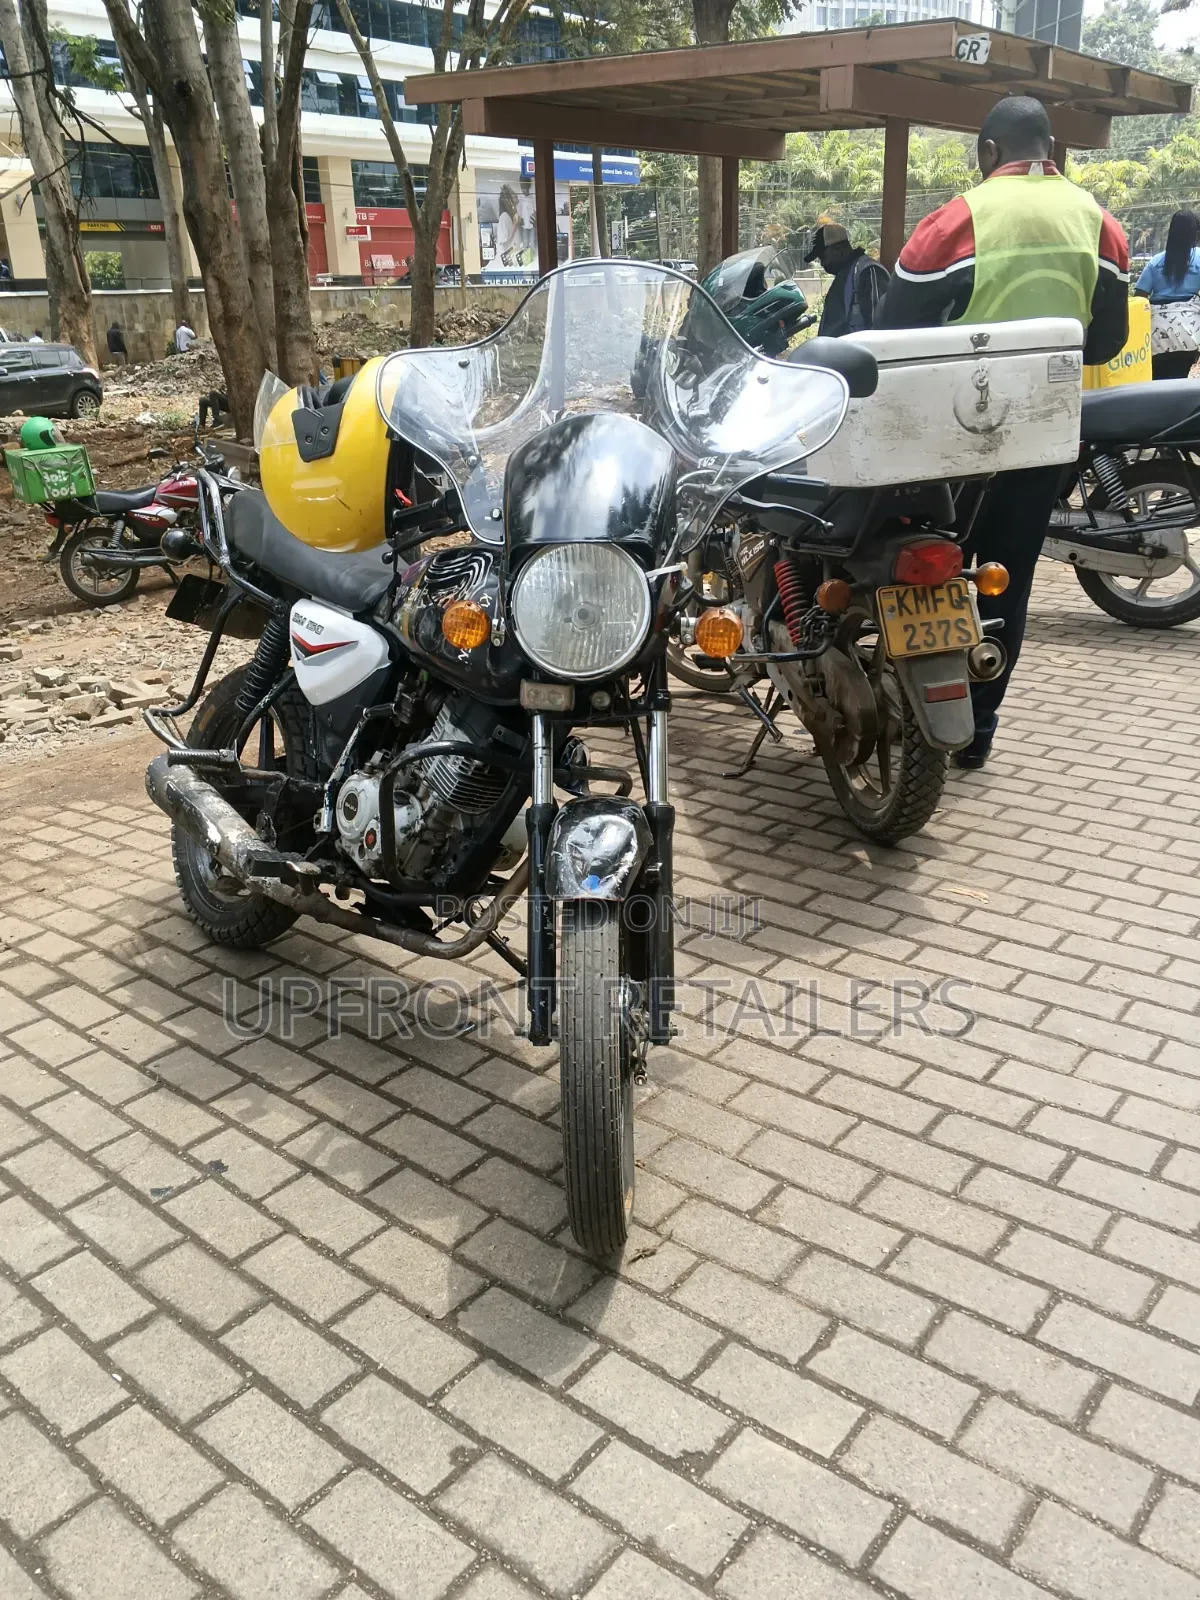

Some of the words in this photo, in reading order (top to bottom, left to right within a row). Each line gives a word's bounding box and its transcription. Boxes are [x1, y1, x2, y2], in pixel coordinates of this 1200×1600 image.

[1107, 346, 1147, 372] Glovo
[896, 584, 966, 617] KMFQ
[903, 618, 972, 650] 237S
